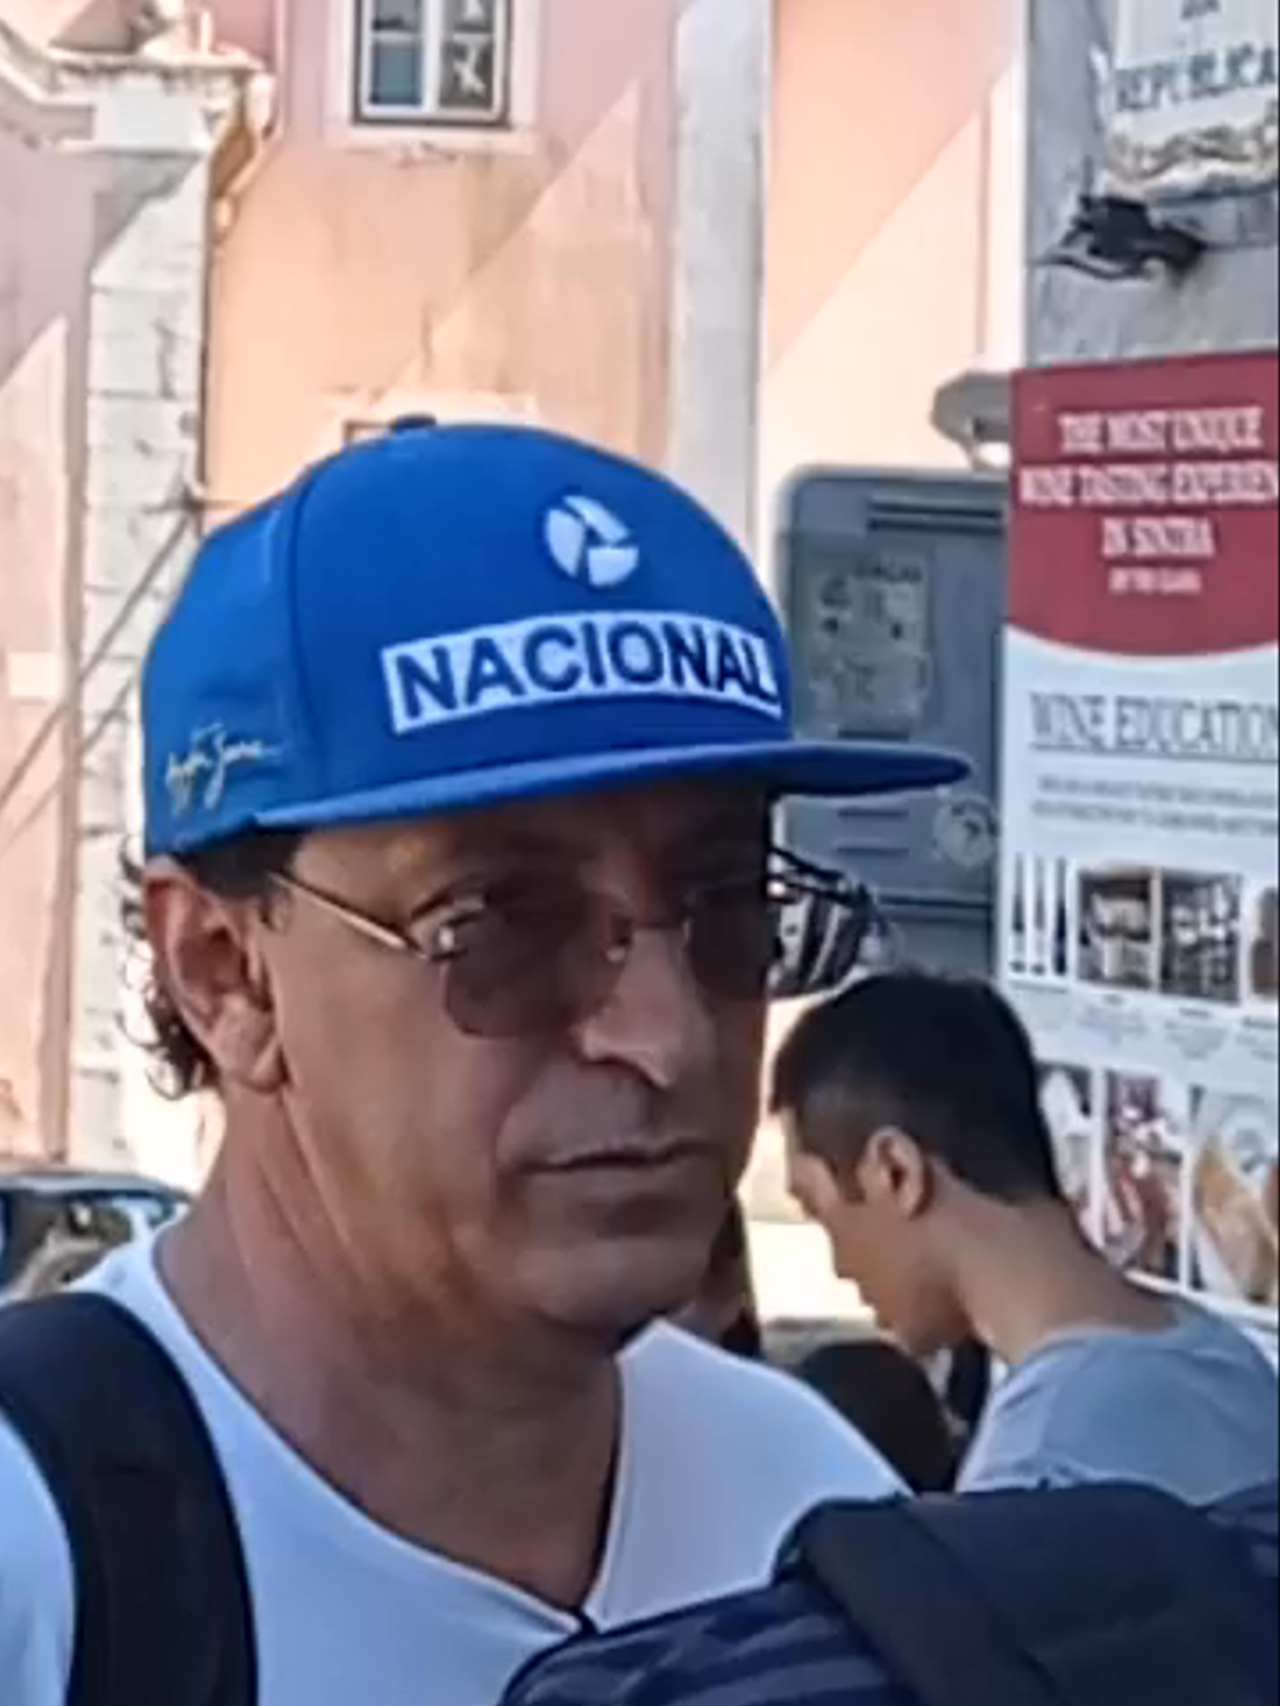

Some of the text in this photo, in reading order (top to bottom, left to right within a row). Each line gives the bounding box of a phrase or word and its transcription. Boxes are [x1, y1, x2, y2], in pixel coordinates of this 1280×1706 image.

[1171, 406, 1265, 453] UNIQUE
[395, 621, 780, 721] NACIONAL
[1028, 690, 1106, 747] WINE
